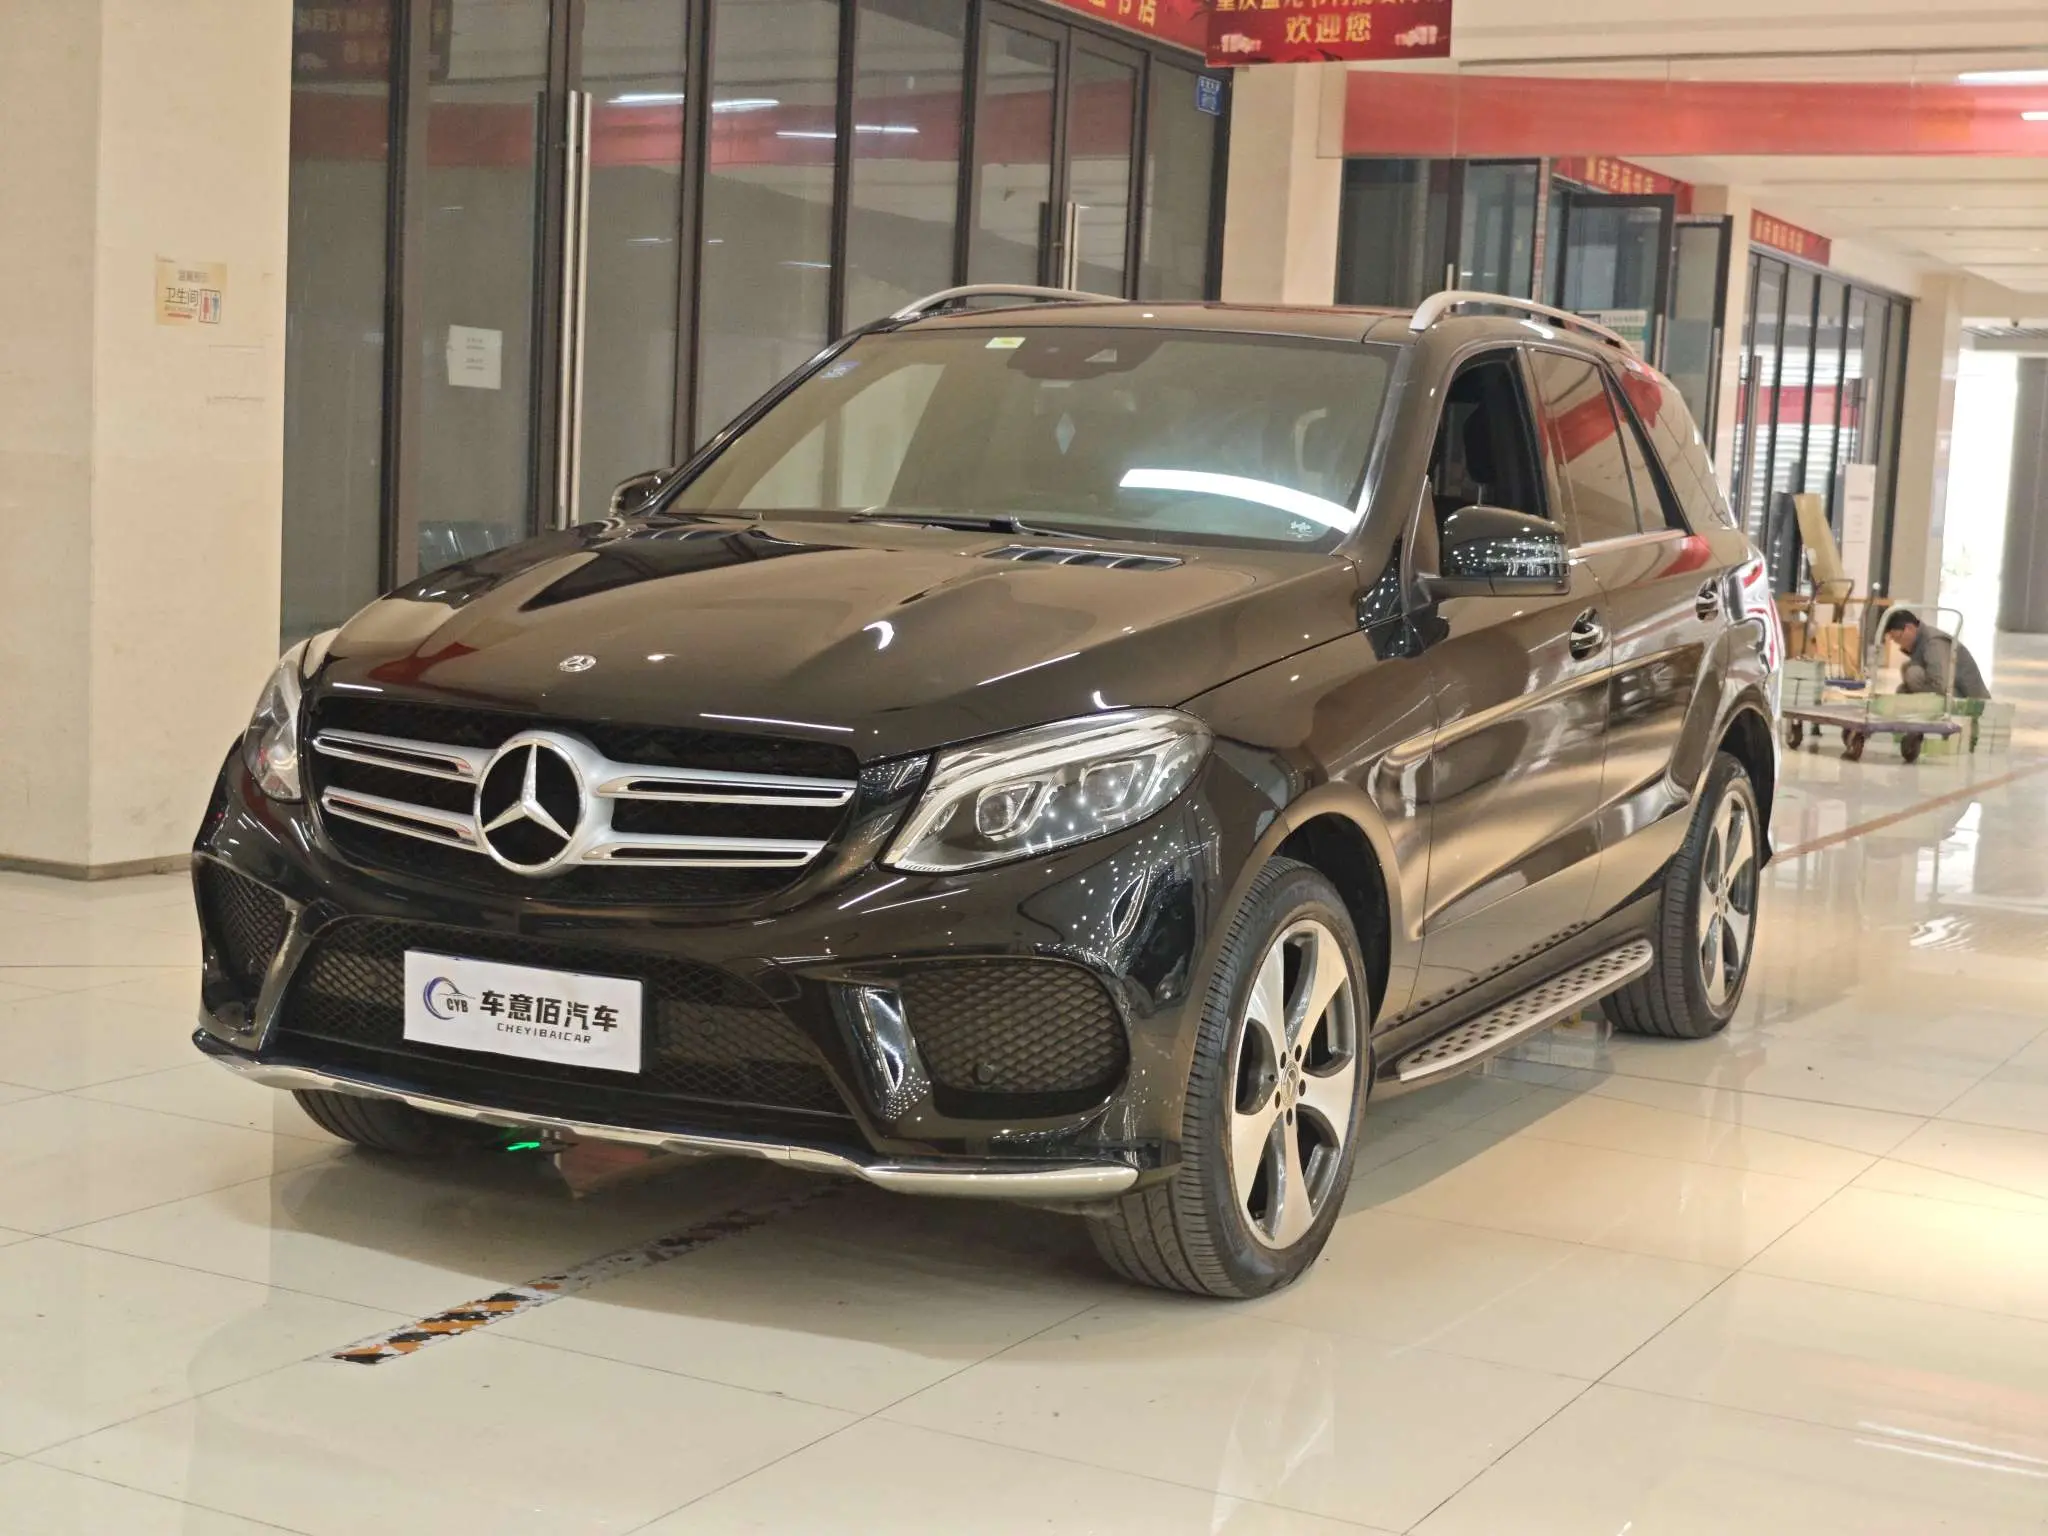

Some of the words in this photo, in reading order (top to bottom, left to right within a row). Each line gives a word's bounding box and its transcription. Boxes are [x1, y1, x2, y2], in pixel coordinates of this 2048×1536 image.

[1285, 12, 1372, 44] 欢迎您
[164, 286, 199, 306] 卫生间
[446, 998, 469, 1013] CYB
[480, 990, 619, 1032] 车意佰汽车
[497, 1022, 592, 1044] CHEYIBAICAR
